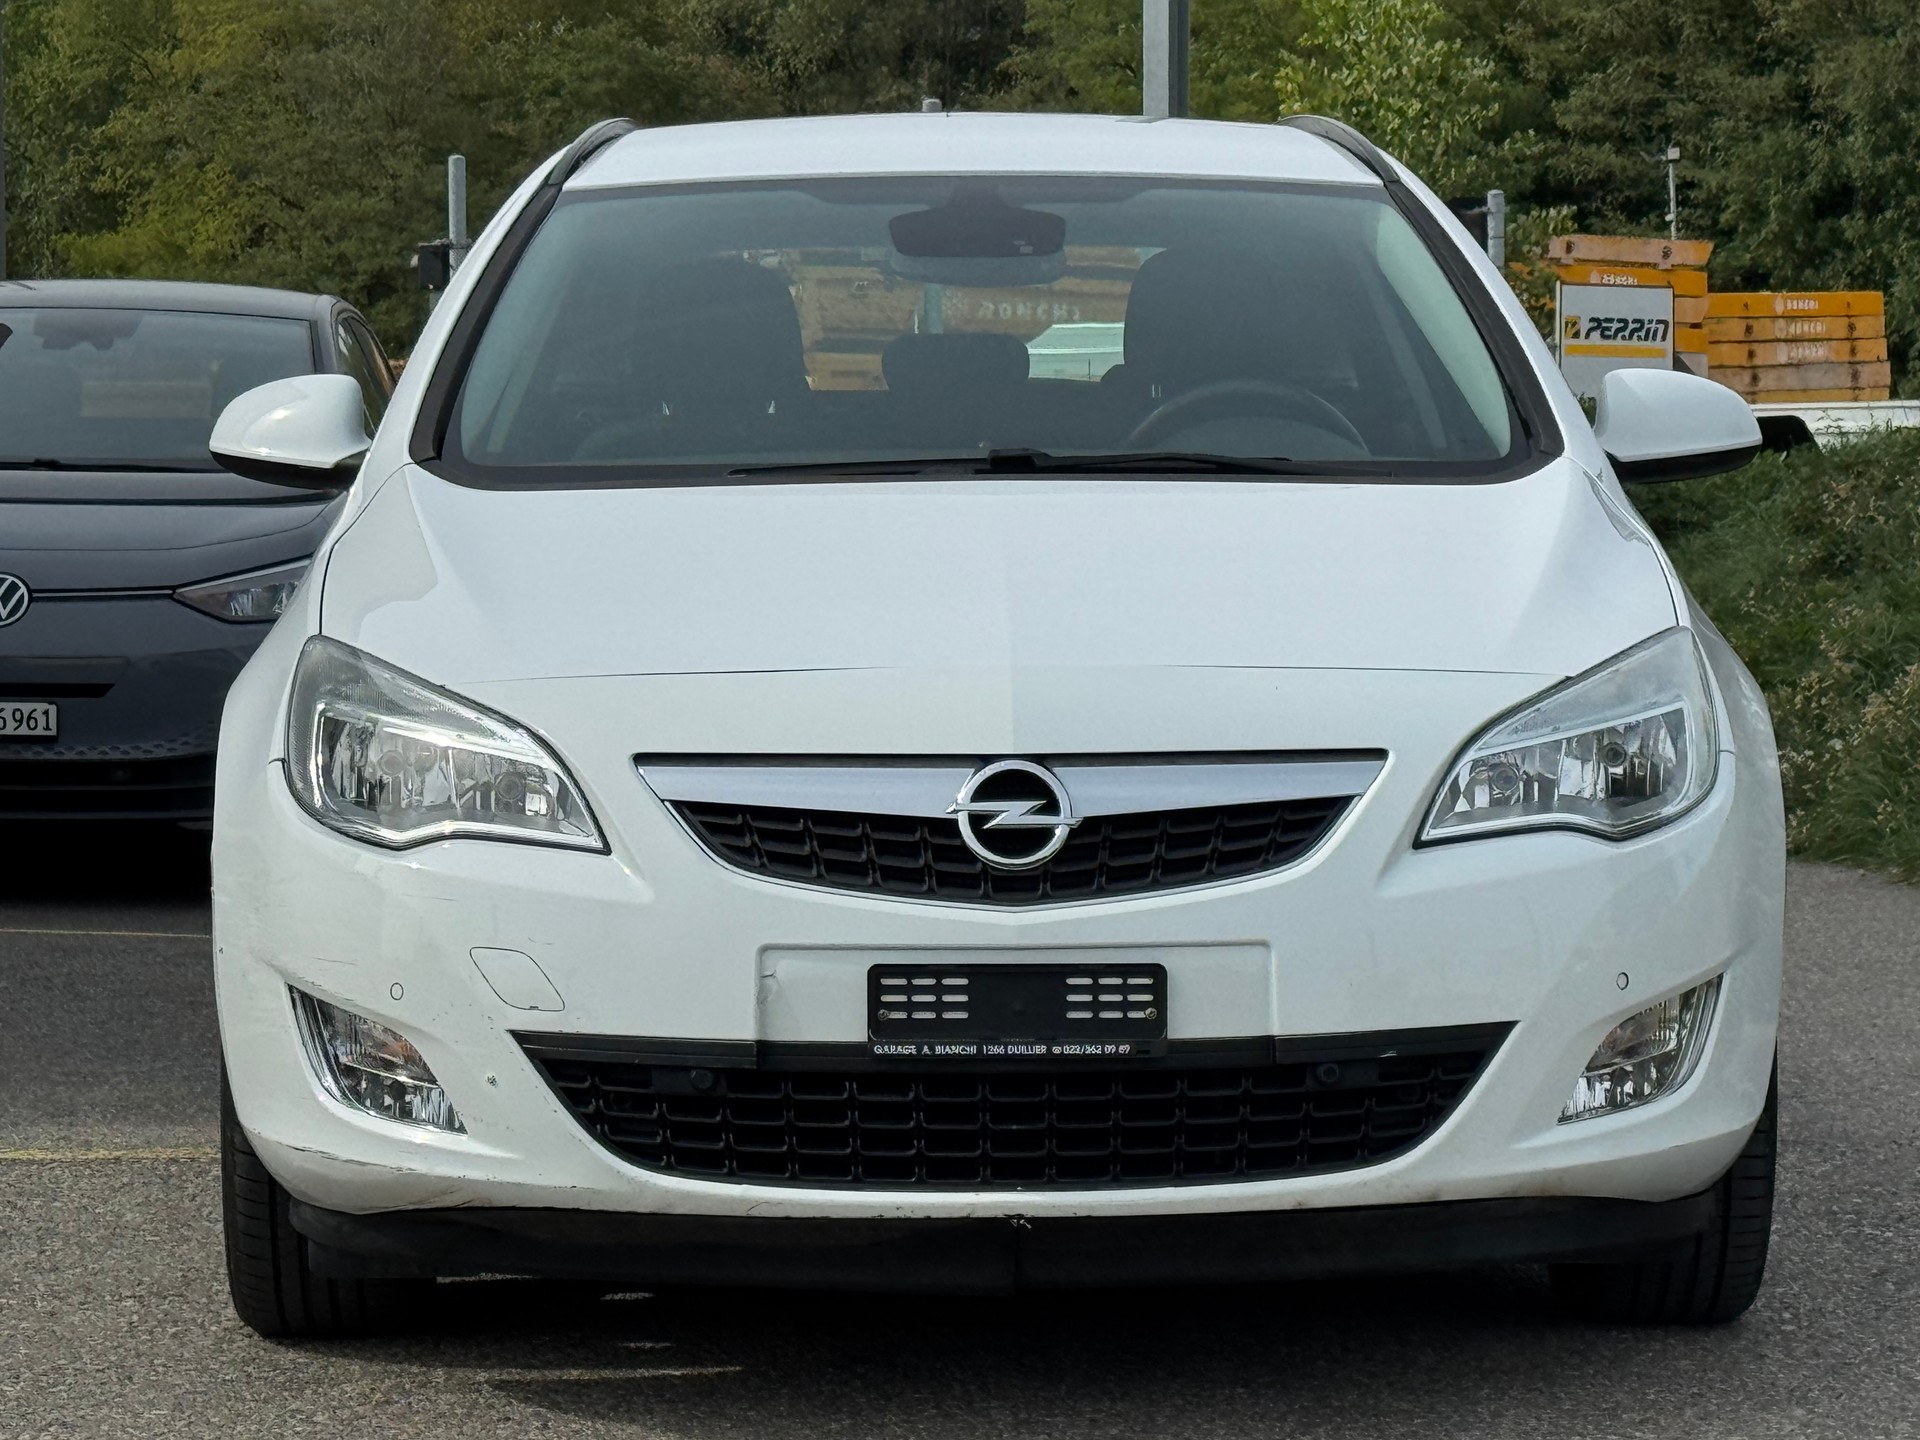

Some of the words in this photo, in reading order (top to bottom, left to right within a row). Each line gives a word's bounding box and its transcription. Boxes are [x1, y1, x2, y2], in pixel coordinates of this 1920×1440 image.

[873, 1044, 917, 1055] GARAGE
[934, 1044, 977, 1055] BIANCHI
[983, 1044, 1005, 1055] 1266
[1007, 1044, 1048, 1055] DUILLIER
